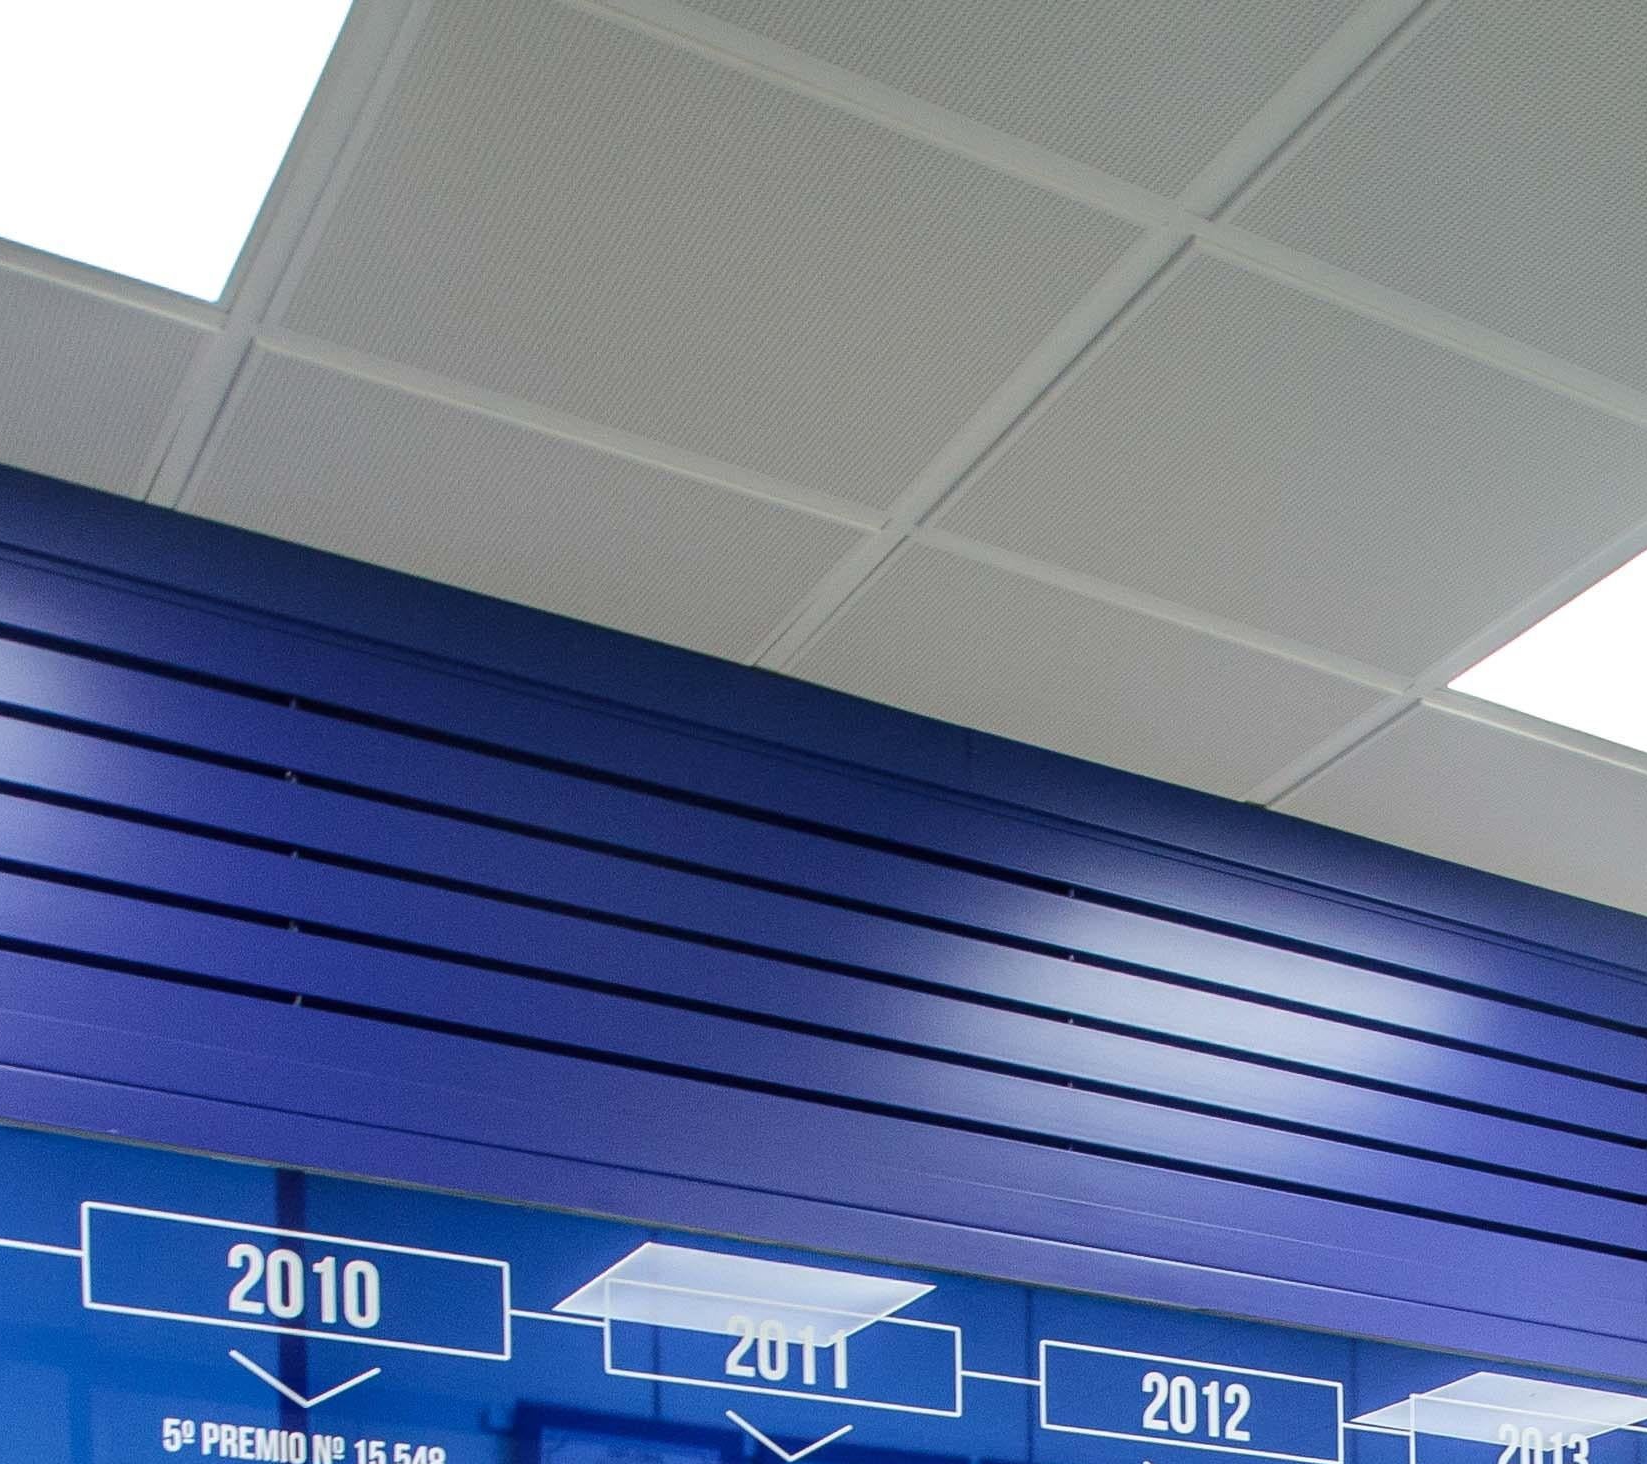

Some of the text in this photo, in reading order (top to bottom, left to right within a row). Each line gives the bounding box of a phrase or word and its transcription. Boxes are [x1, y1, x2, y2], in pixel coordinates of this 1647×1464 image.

[227, 1242, 381, 1329] 2010
[724, 1315, 850, 1390] 2011
[161, 1417, 196, 1453] 5º
[200, 1421, 307, 1464] PREMIO
[1141, 1371, 1251, 1442] 2012
